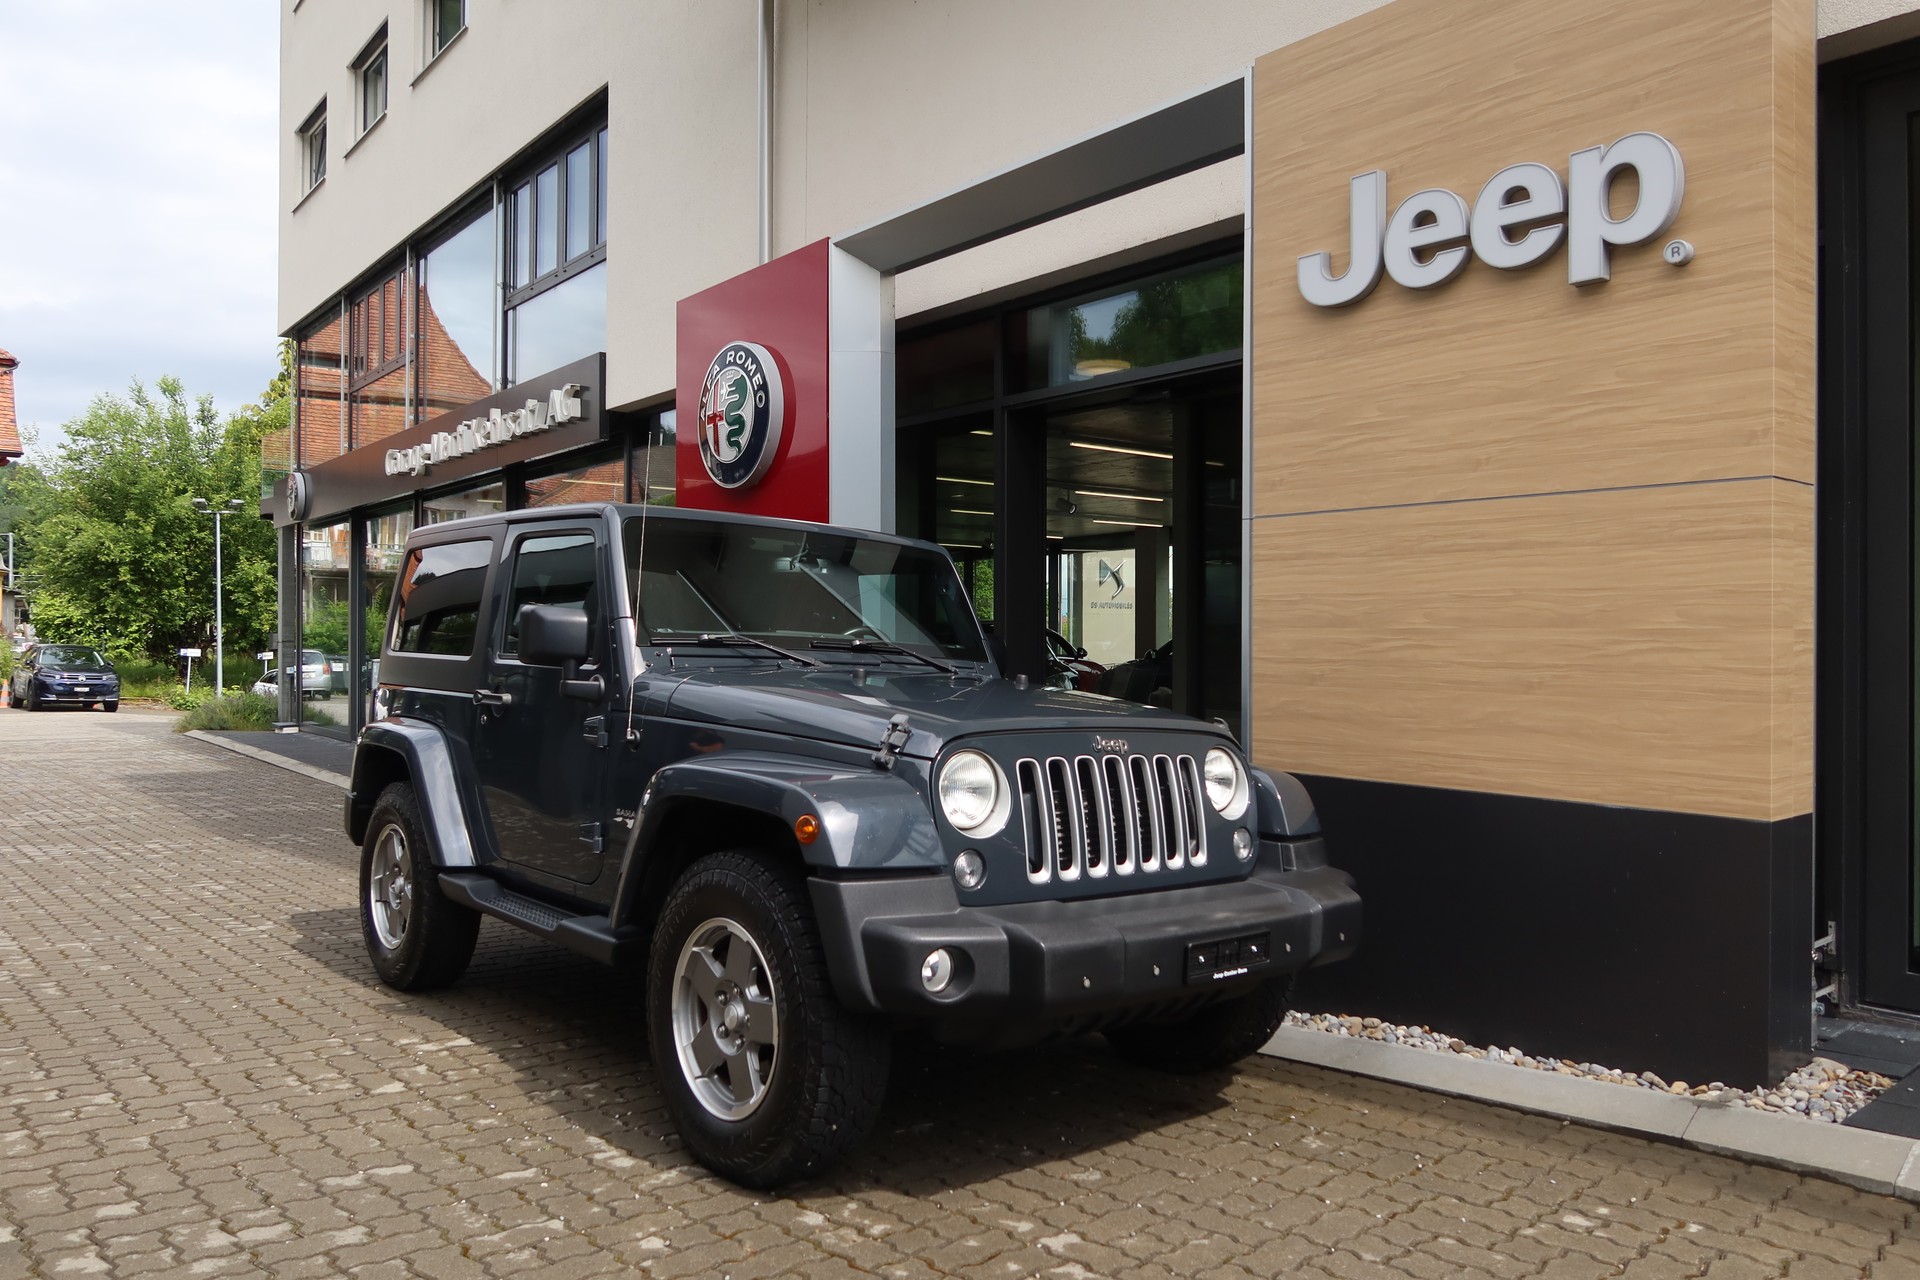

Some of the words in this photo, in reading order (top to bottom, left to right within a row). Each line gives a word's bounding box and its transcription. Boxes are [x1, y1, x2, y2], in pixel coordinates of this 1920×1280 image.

[1297, 131, 1686, 307] Jeep
[546, 383, 582, 424] AG
[700, 364, 721, 421] ALFA
[725, 350, 766, 409] ROMEO
[1092, 735, 1128, 754] Jeep
